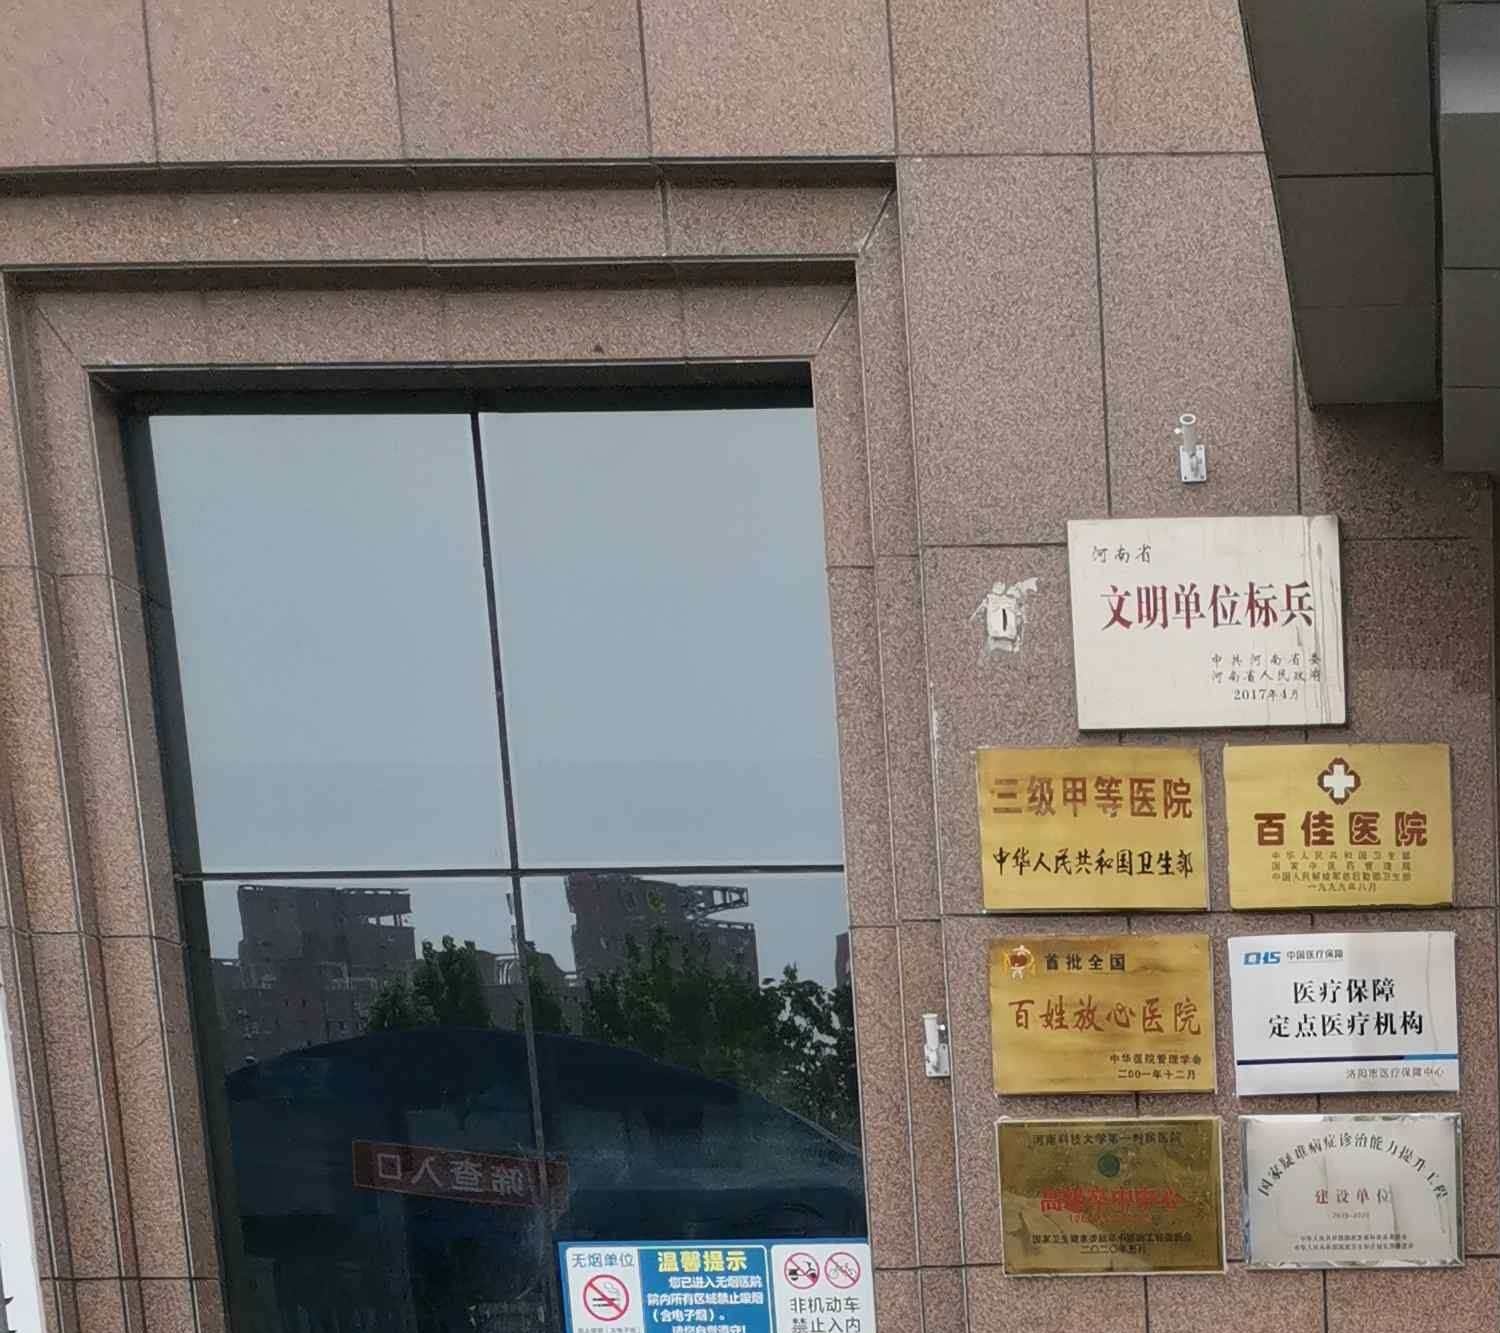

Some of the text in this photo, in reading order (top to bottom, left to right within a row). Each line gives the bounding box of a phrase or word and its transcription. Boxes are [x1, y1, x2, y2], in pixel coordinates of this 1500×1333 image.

[1092, 545, 1152, 563] 河南省
[1100, 581, 1316, 630] 文明单位标兵
[1211, 652, 1321, 666] 中共河南省委
[1210, 669, 1321, 683] 河南省人民政府
[991, 776, 1193, 820] 三级甲等医院
[1254, 811, 1428, 847] 百佳医院
[992, 847, 1194, 877] 中华人民共和国卫生部
[1044, 953, 1127, 971] 首批全国
[1286, 949, 1344, 960] 中国医疗保障
[1293, 978, 1395, 1004] 医疗保障
[1008, 995, 1201, 1036] 百姓放心医院
[1268, 1010, 1424, 1039] 定点医疗机构
[1109, 1053, 1202, 1066] 中华医院管理学会
[1315, 1188, 1391, 1204] 建设单位
[571, 1253, 634, 1268] 无烟单位
[658, 1250, 748, 1272] 温馨提示
[789, 1296, 861, 1314] 非机动车
[791, 1317, 861, 1333] 禁止入内
